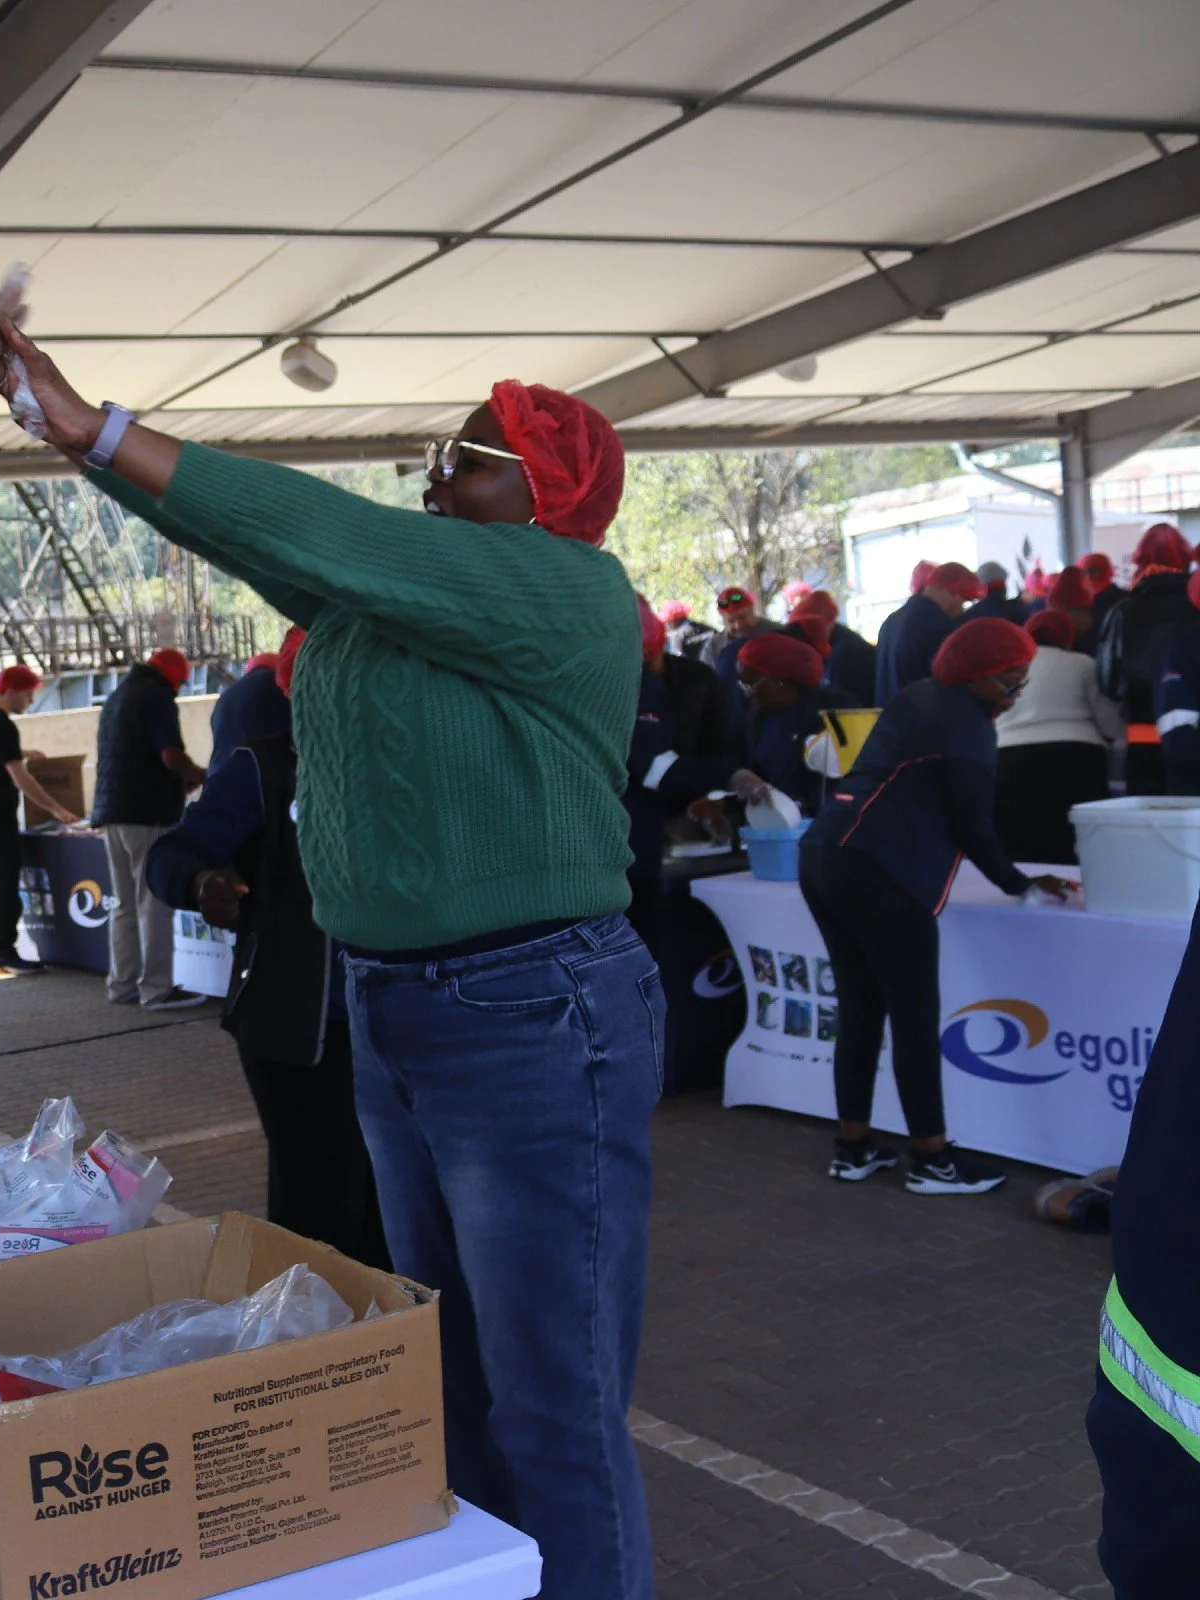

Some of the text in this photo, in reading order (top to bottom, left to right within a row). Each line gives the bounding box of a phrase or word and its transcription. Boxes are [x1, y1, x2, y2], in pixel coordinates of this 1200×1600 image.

[1055, 1027, 1153, 1072] egoli
[213, 1344, 405, 1403] Nutritional Supplement (Proprietary Food)
[234, 1363, 391, 1414] FOR INSTITUTIONAL SALES ONLY
[192, 1421, 249, 1441] FOR EXPORTS
[193, 1419, 293, 1451] Manufactured On Behalf of
[328, 1408, 401, 1435] Micronutrient sachets
[341, 1425, 377, 1441] sponsored
[379, 1422, 389, 1430] by:
[328, 1418, 432, 1455] Kraft Heinz Company Foundation
[399, 1442, 414, 1451] USA
[194, 1442, 249, 1461] KraftHeinz for:
[194, 1447, 266, 1470] Rise Against Hunger
[216, 1463, 245, 1475] National
[268, 1452, 285, 1462] Suite
[29, 1442, 169, 1504] Rise
[196, 1479, 225, 1491] Raleigh,
[228, 1473, 238, 1482] NC
[266, 1461, 283, 1473] USA
[196, 1470, 290, 1501] www.riseagainsthunger.org
[330, 1459, 422, 1492] www.kraftheinzcompany.com
[342, 1470, 359, 1479] more
[35, 1479, 171, 1521] AGAINST HUNGER
[198, 1497, 263, 1520] Manufactured by:
[307, 1507, 329, 1519] INDIA
[221, 1542, 248, 1555] Licence
[250, 1532, 277, 1547] Number
[29, 1548, 182, 1600] KraftHeinz
